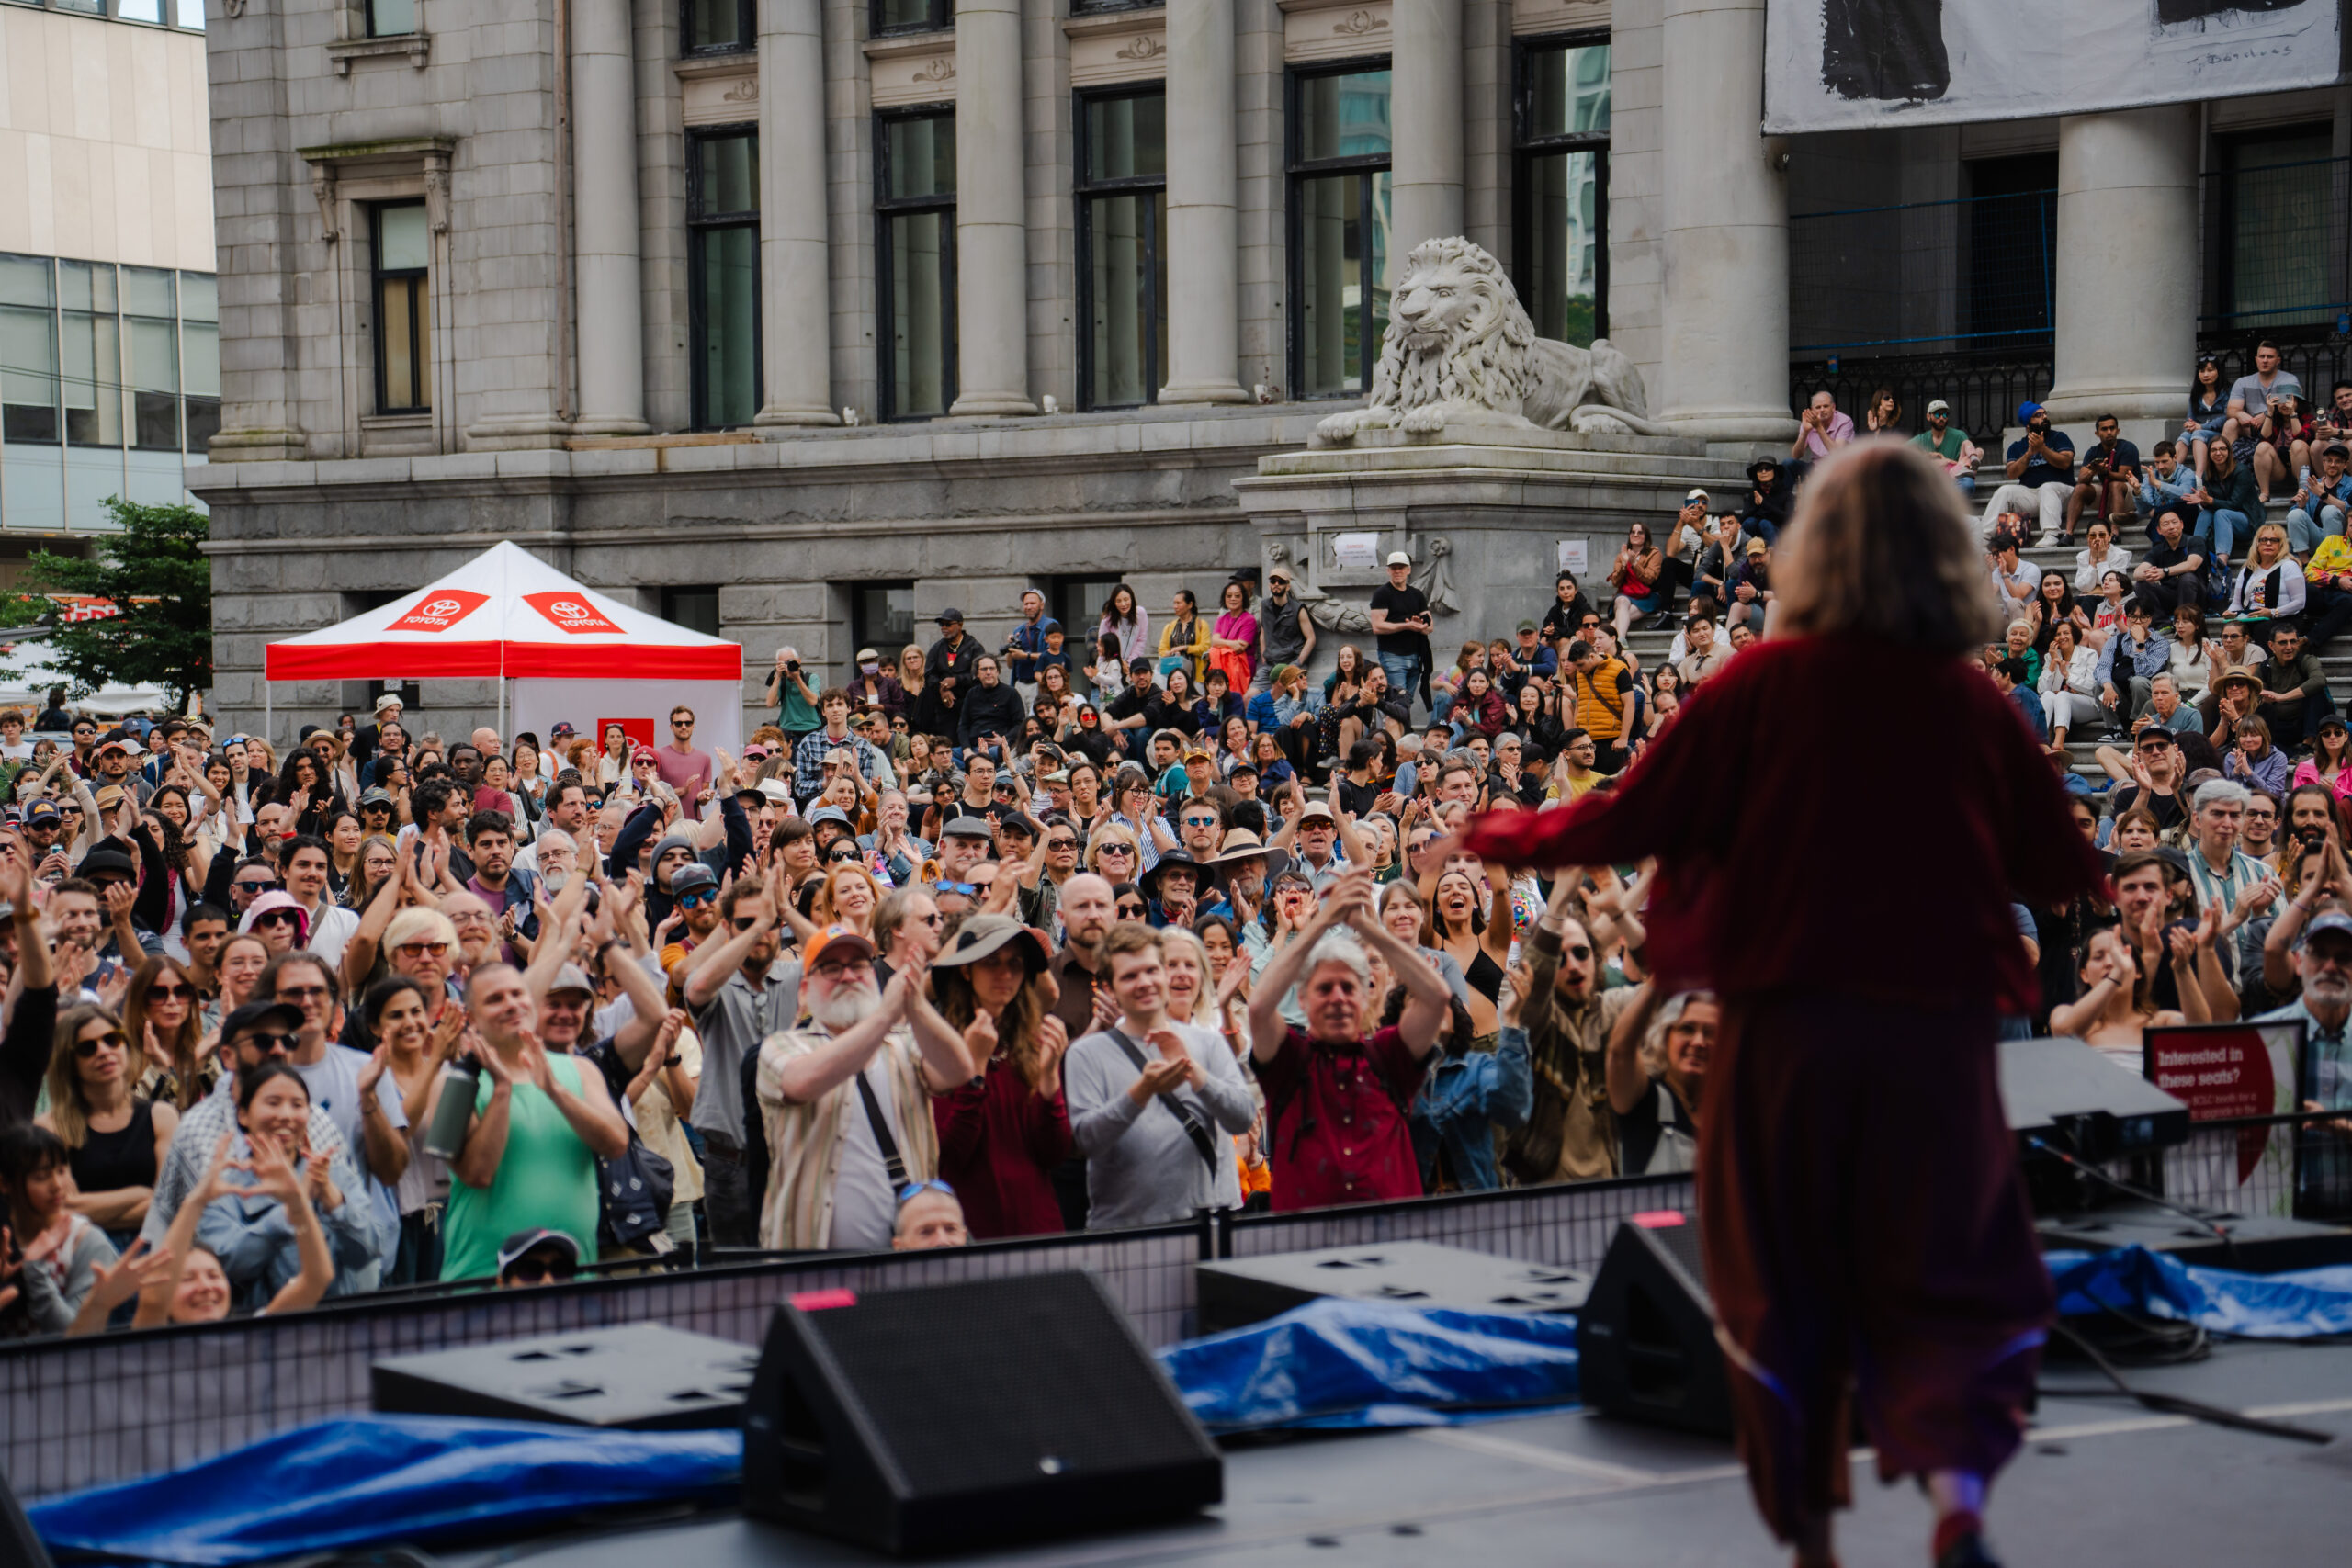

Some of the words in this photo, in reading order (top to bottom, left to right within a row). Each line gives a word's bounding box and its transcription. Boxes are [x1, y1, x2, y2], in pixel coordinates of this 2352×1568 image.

[403, 615, 450, 626] TOYOTA
[559, 618, 610, 627] TOYOTA
[2158, 1047, 2227, 1066] Interested
[2230, 1046, 2244, 1062] in
[2158, 1072, 2196, 1089] these
[2199, 1066, 2241, 1086] seats?
